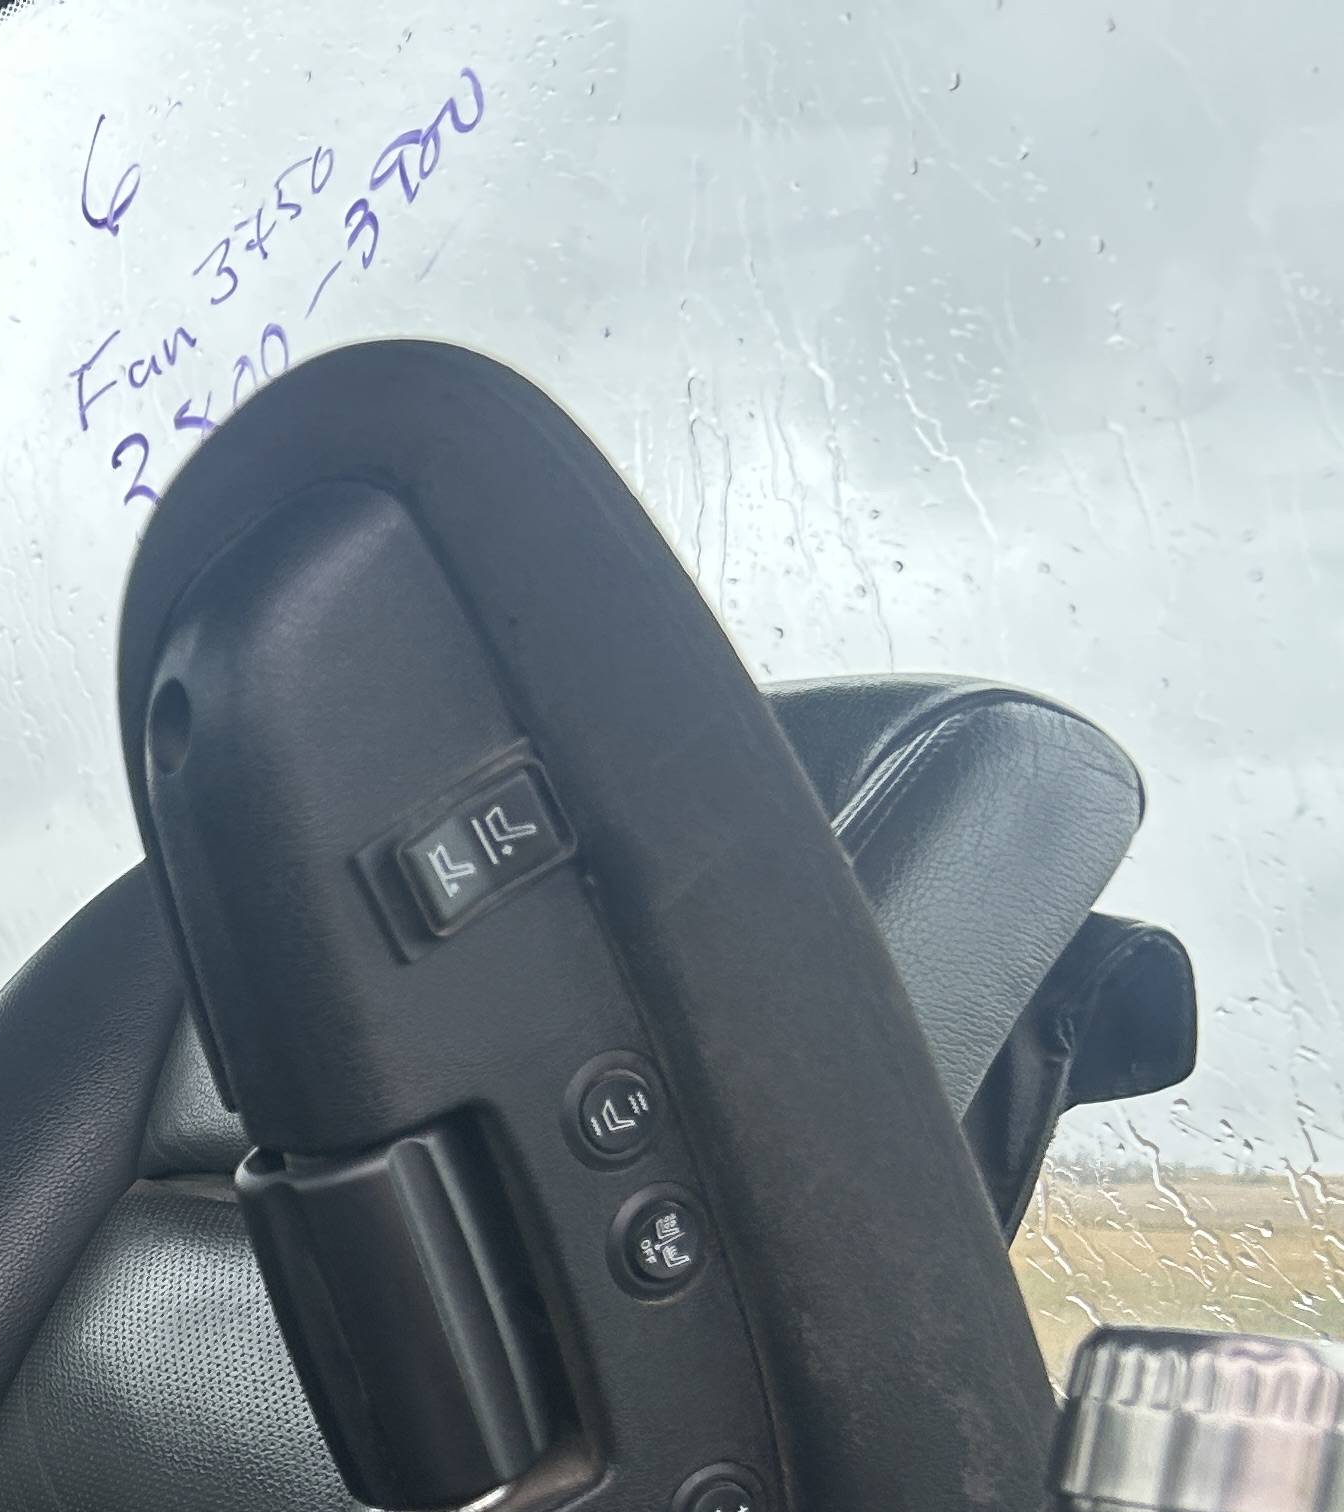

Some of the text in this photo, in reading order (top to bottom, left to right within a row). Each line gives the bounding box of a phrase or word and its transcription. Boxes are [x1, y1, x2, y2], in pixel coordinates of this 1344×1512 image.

[80, 114, 141, 236] 6
[69, 329, 197, 431] Fan
[640, 1239, 658, 1264] OFF
